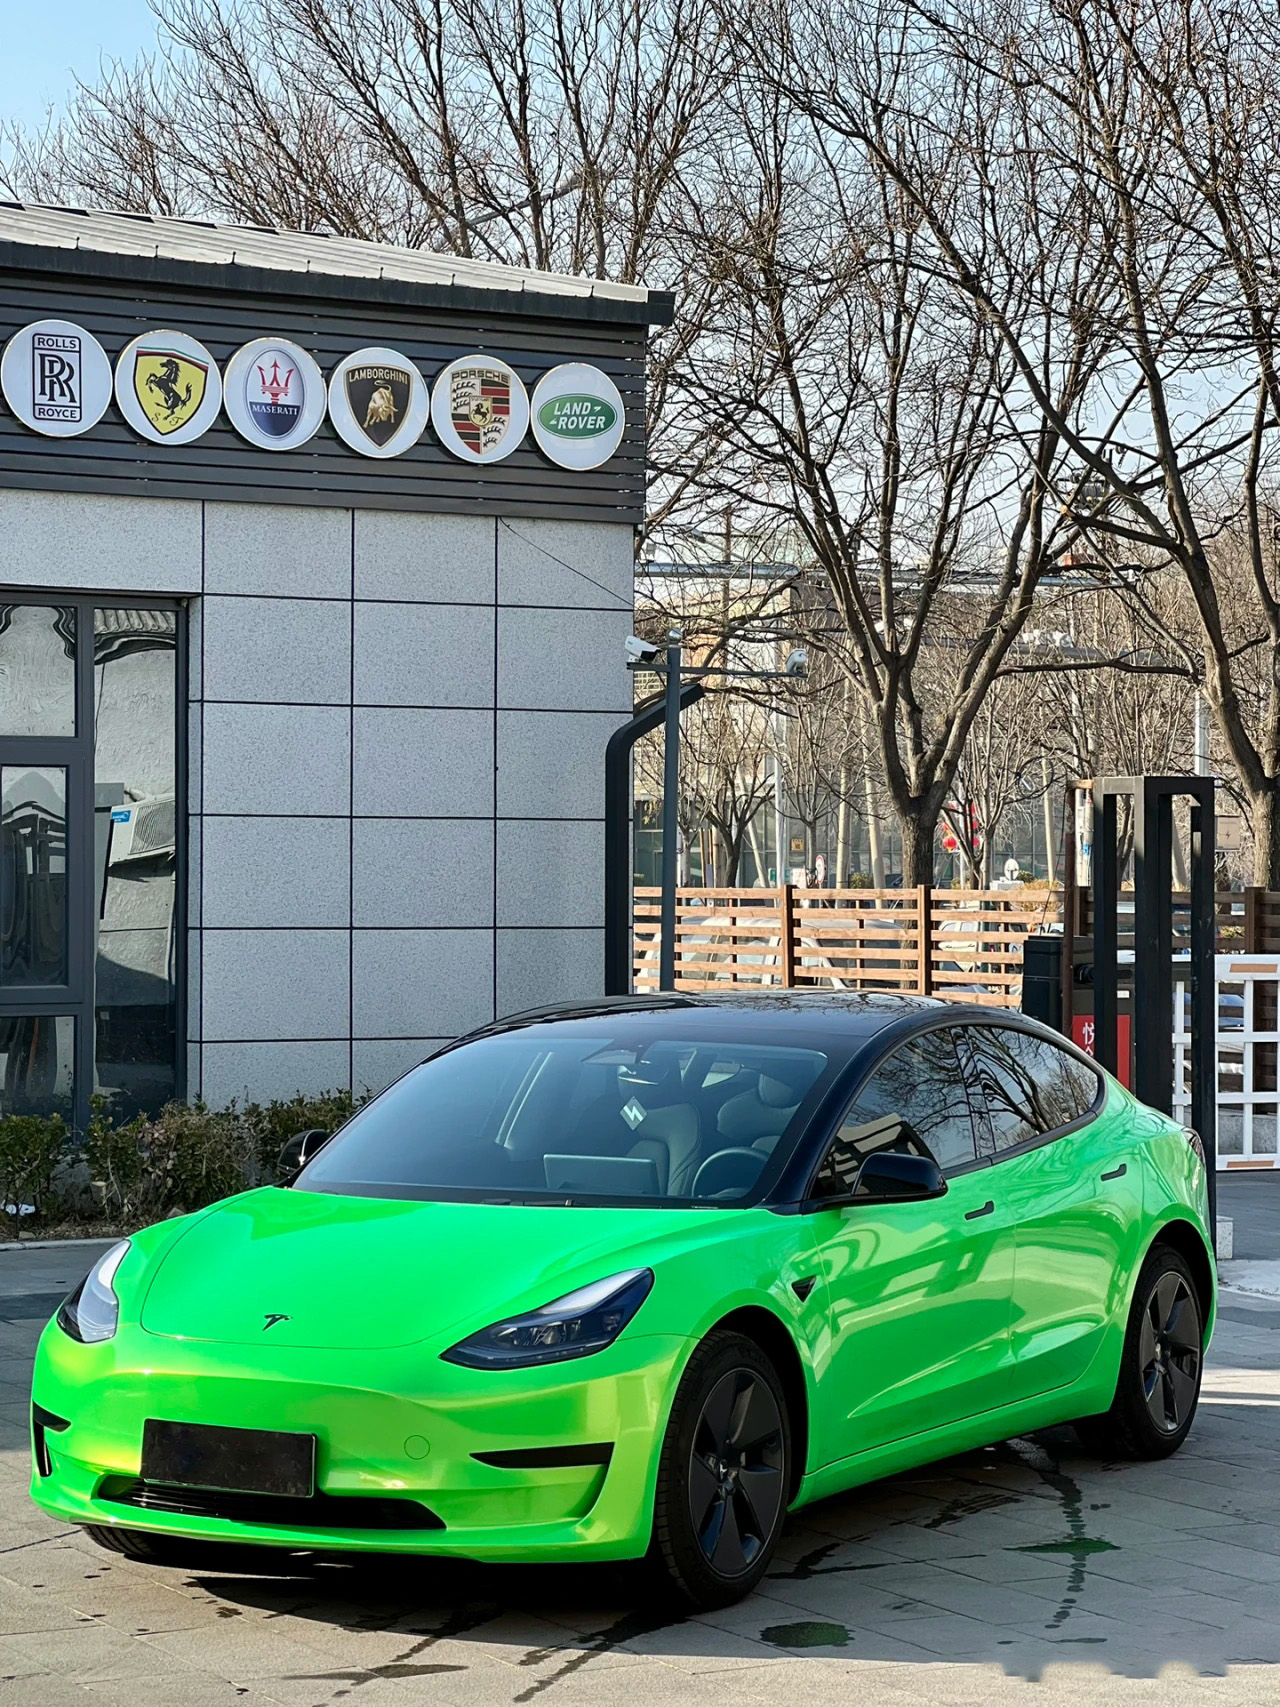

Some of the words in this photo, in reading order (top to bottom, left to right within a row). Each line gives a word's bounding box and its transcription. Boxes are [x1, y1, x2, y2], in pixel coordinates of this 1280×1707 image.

[37, 337, 77, 349] ROLLS
[38, 353, 77, 403] RR
[349, 368, 408, 384] LAMBORGHINI
[452, 370, 509, 384] PORSCHE
[38, 407, 77, 418] ROYCE
[252, 404, 298, 415] MASERATI
[553, 402, 592, 415] LAND
[151, 412, 161, 422] S
[557, 416, 606, 429] ROVER
